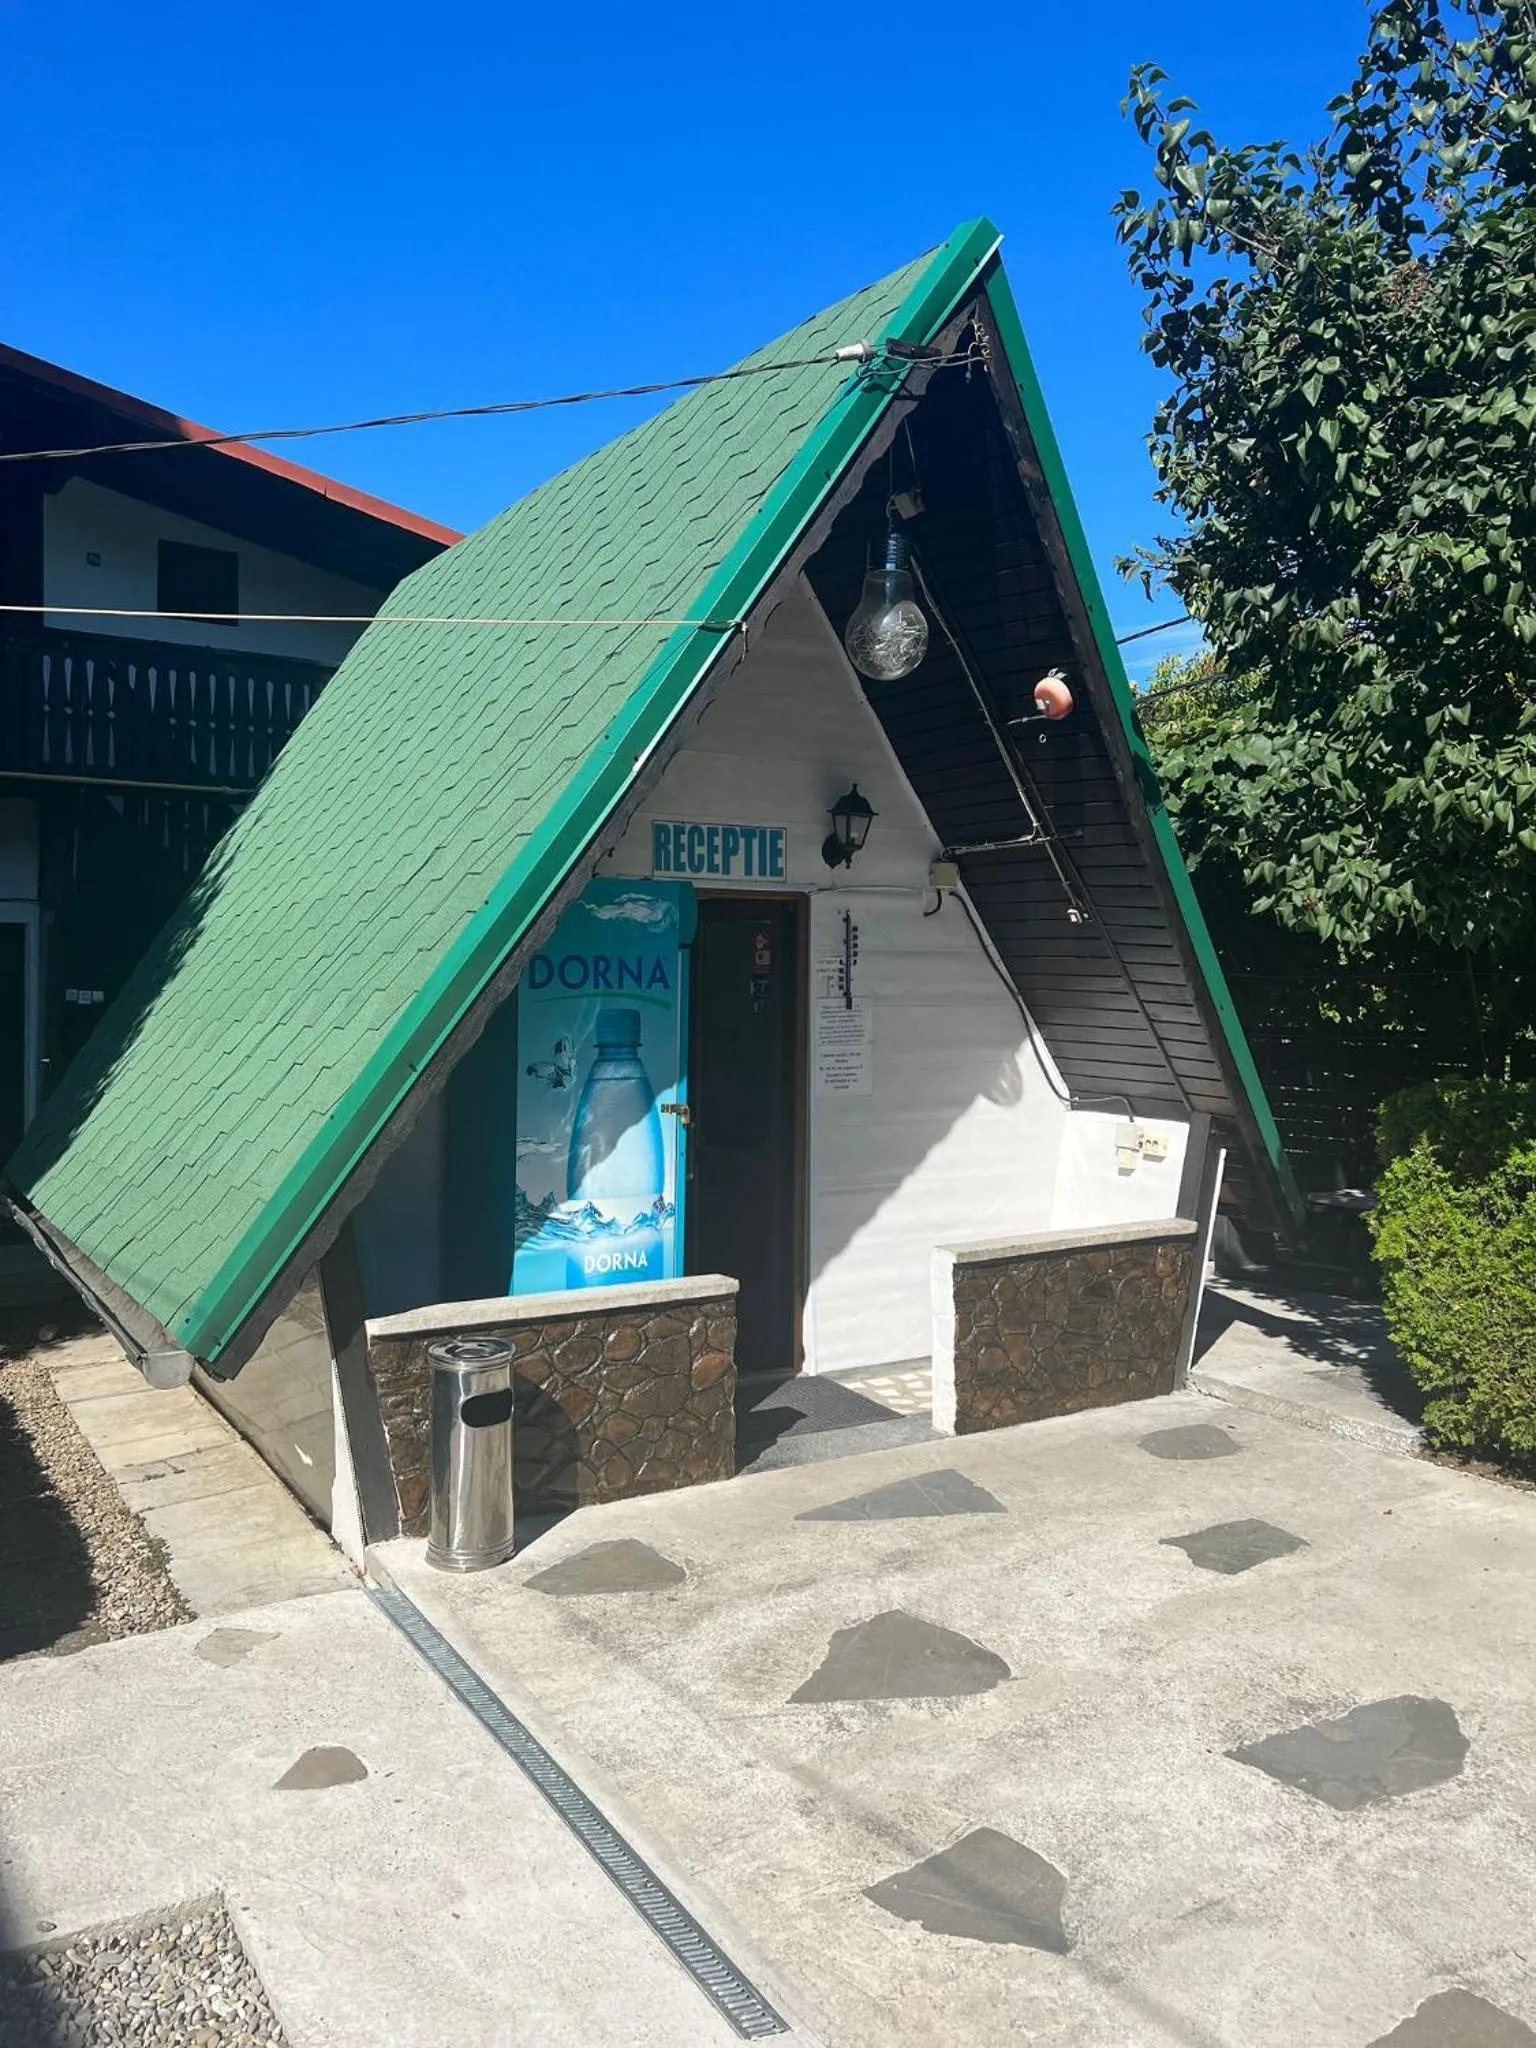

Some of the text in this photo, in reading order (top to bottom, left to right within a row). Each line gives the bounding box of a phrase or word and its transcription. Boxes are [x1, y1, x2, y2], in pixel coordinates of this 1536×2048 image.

[654, 823, 784, 877] RECEPTIE
[528, 953, 671, 990] DORNA
[583, 1247, 648, 1274] DORNA
